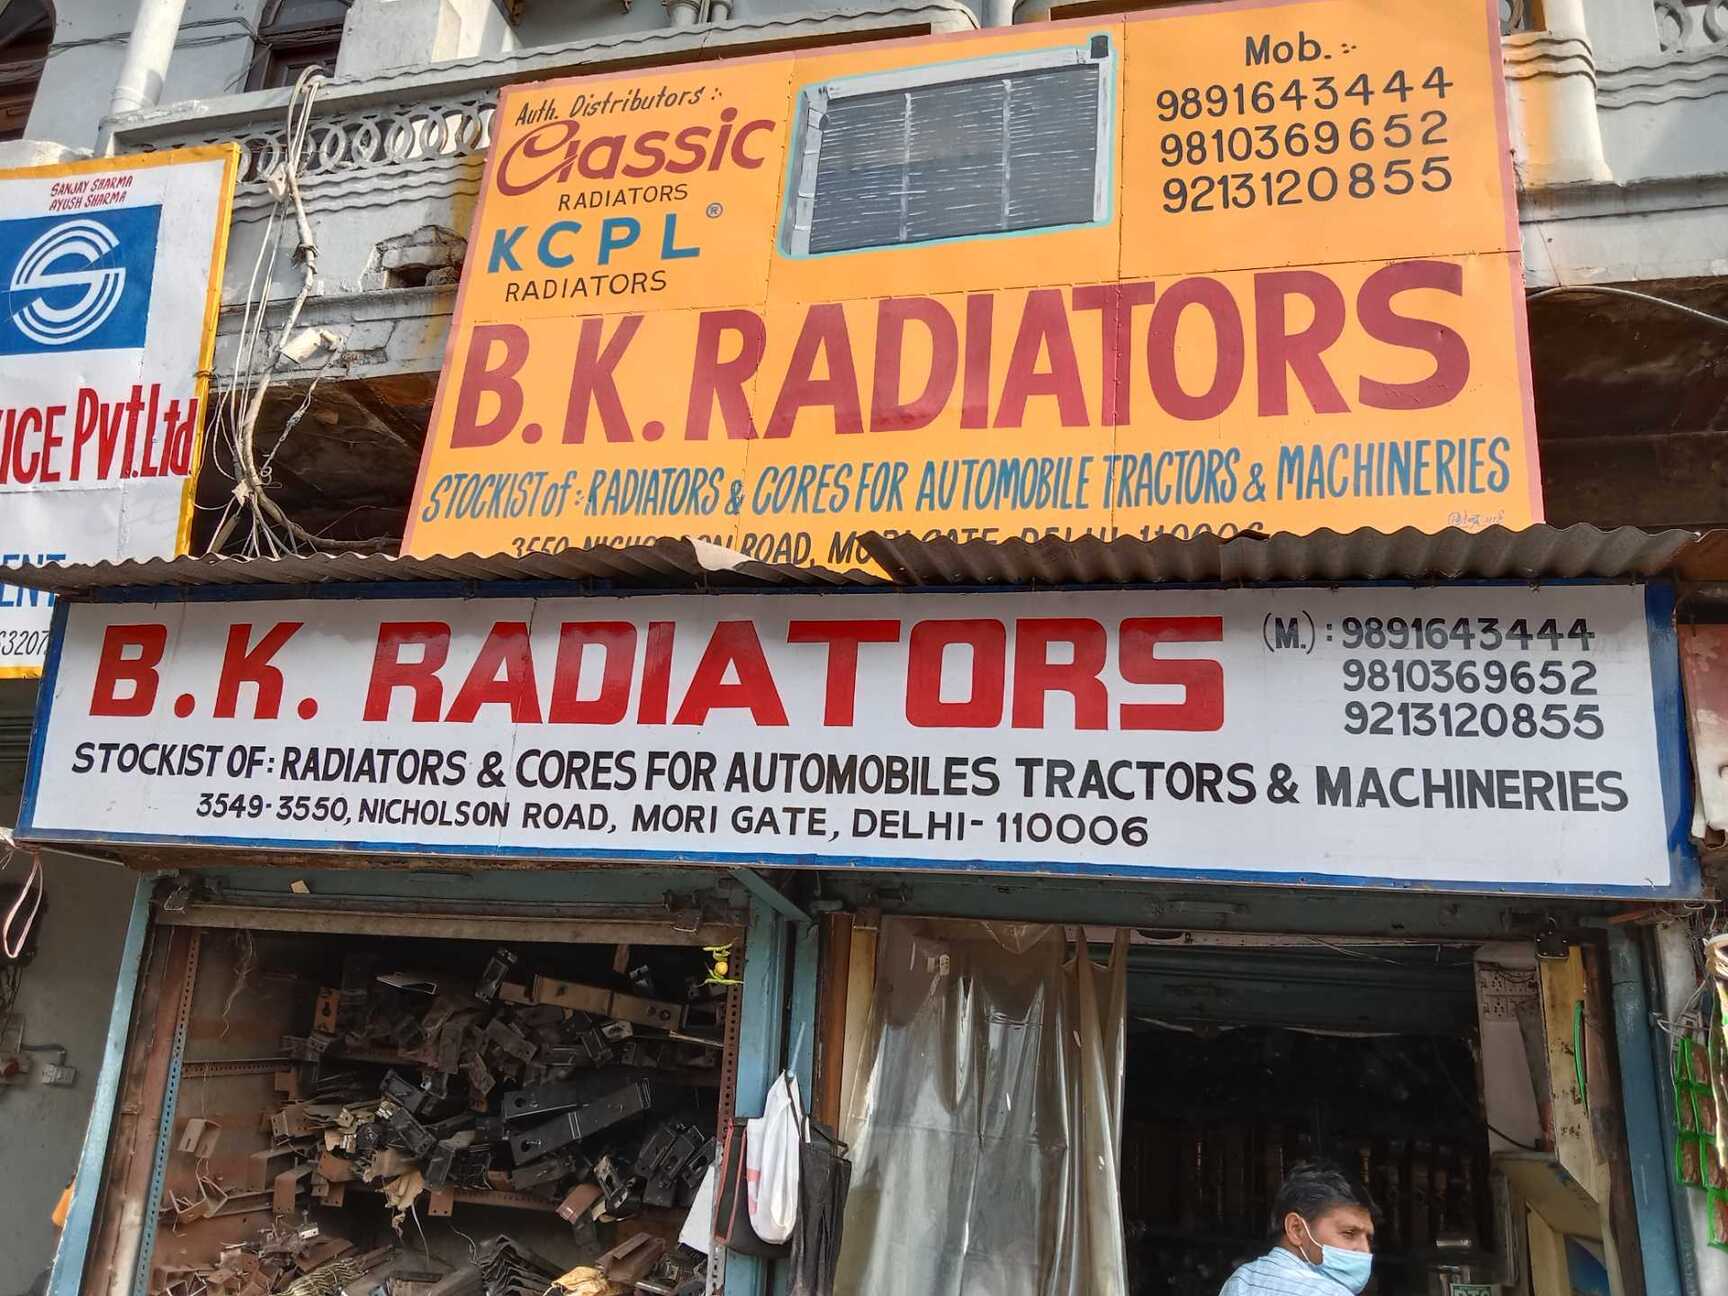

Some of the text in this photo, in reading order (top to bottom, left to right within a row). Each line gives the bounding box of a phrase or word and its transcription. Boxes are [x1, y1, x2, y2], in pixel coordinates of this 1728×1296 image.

[515, 99, 559, 126] Auth.
[570, 86, 704, 117] Distributors
[1156, 66, 1453, 122] 9891643444
[496, 106, 776, 196] Classic
[1160, 110, 1448, 167] 9810369652
[48, 191, 127, 211] AYUSH SHARMA
[50, 175, 134, 197] SANJAY SHARMA
[558, 183, 688, 211] RADIATORS
[1163, 156, 1452, 214] 9213120855
[504, 270, 668, 302] RADIATORS
[683, 259, 1471, 441] RADIATORS
[0, 405, 67, 485] ICE
[421, 470, 548, 522] STOCKIST
[584, 466, 726, 516] RADIATORS
[728, 479, 745, 515] &
[751, 463, 851, 514] CORES
[853, 461, 908, 511] FOR
[916, 456, 1094, 512] AUTOMOBILE
[1102, 447, 1242, 506] TRACTORS
[1249, 464, 1267, 503] &
[1276, 437, 1512, 501] MACHINERIES
[362, 616, 1224, 731] RADIATORS
[1341, 616, 1596, 651] 9891643444
[1342, 658, 1598, 695] 9810369652
[1343, 700, 1605, 740] 9213120855
[71, 741, 224, 777] STOCKIST
[279, 746, 467, 787] RADIATORS
[476, 750, 506, 789] &
[515, 748, 634, 790] CORES
[645, 750, 717, 793] FOR
[724, 752, 1000, 798] AUTOMOBILES
[1015, 757, 1256, 804] TRACTORS
[1267, 762, 1300, 804] &
[1315, 765, 1629, 812] MACHINERIES
[358, 798, 509, 828] NICHOLSON
[521, 802, 617, 834] ROAD,
[631, 803, 718, 833] MORI
[731, 805, 841, 842] GATE,
[997, 811, 1149, 847] 110006
